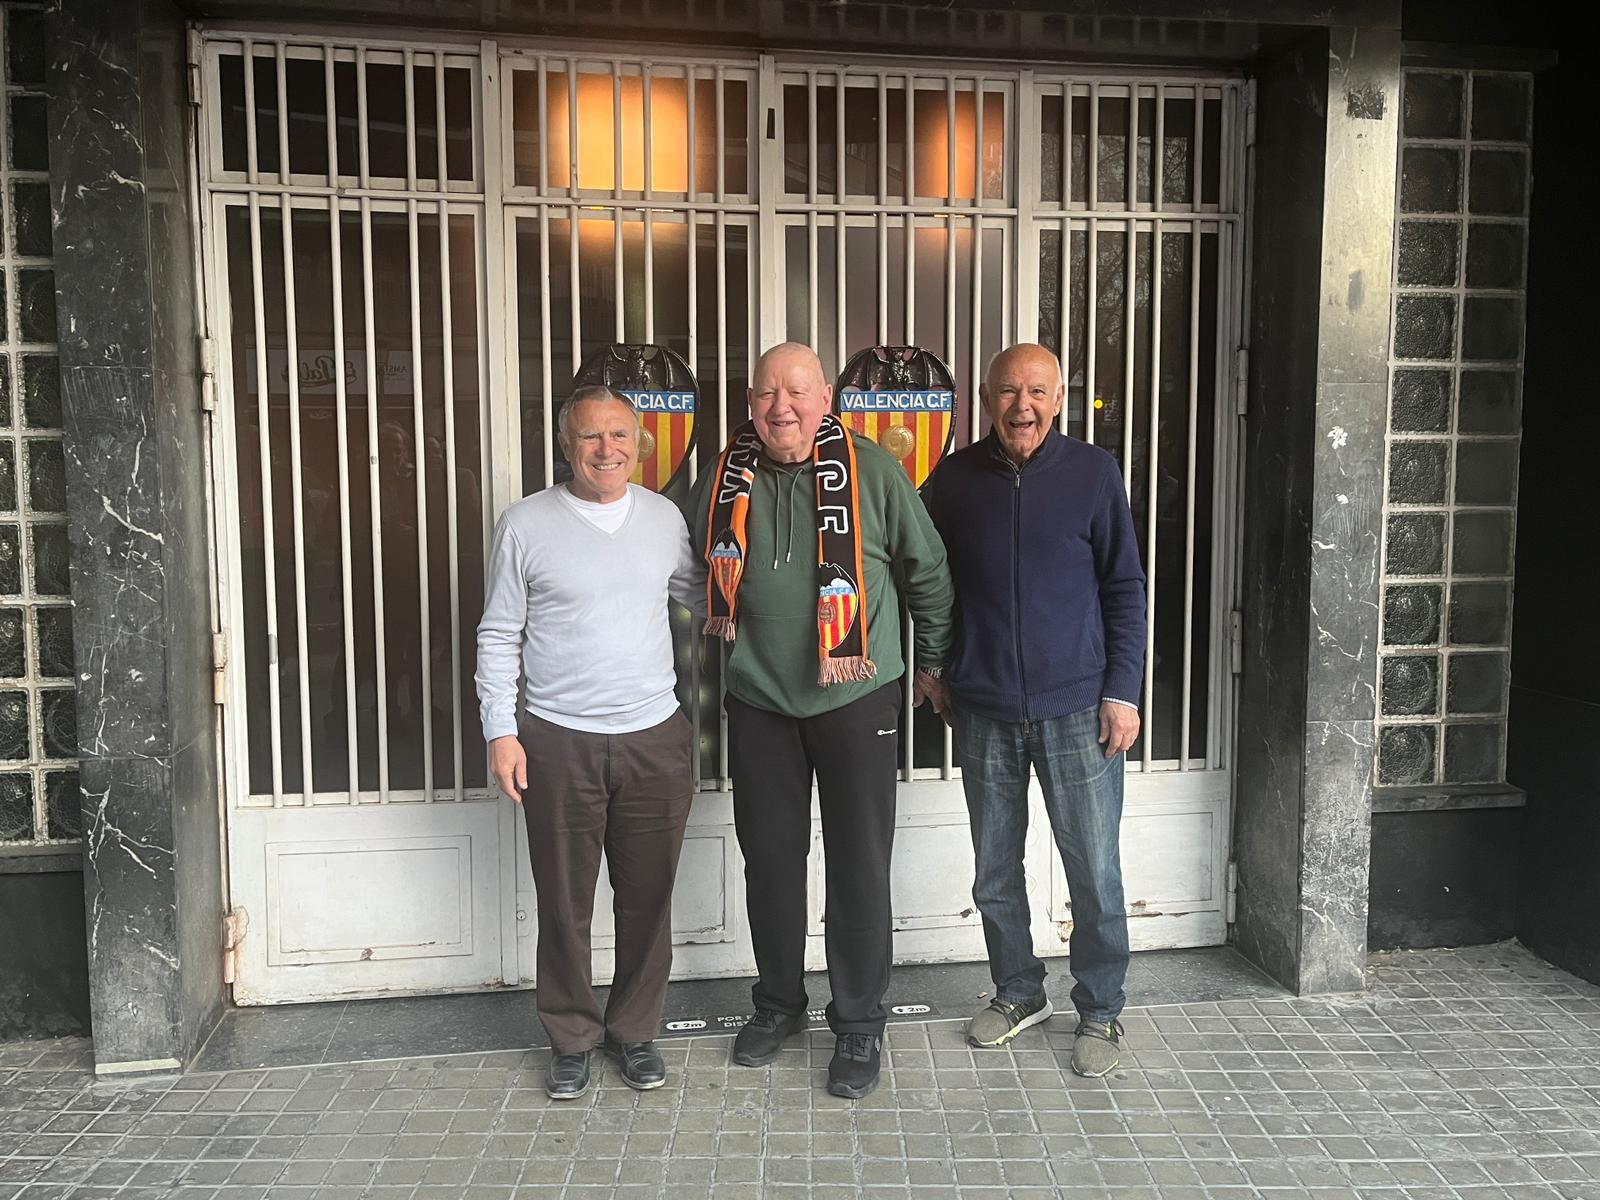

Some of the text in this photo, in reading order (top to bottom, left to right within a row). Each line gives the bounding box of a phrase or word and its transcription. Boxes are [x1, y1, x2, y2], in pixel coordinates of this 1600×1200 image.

[621, 393, 667, 409] NCIA
[843, 393, 925, 409] VALENCIA
[717, 1015, 743, 1023] POR
